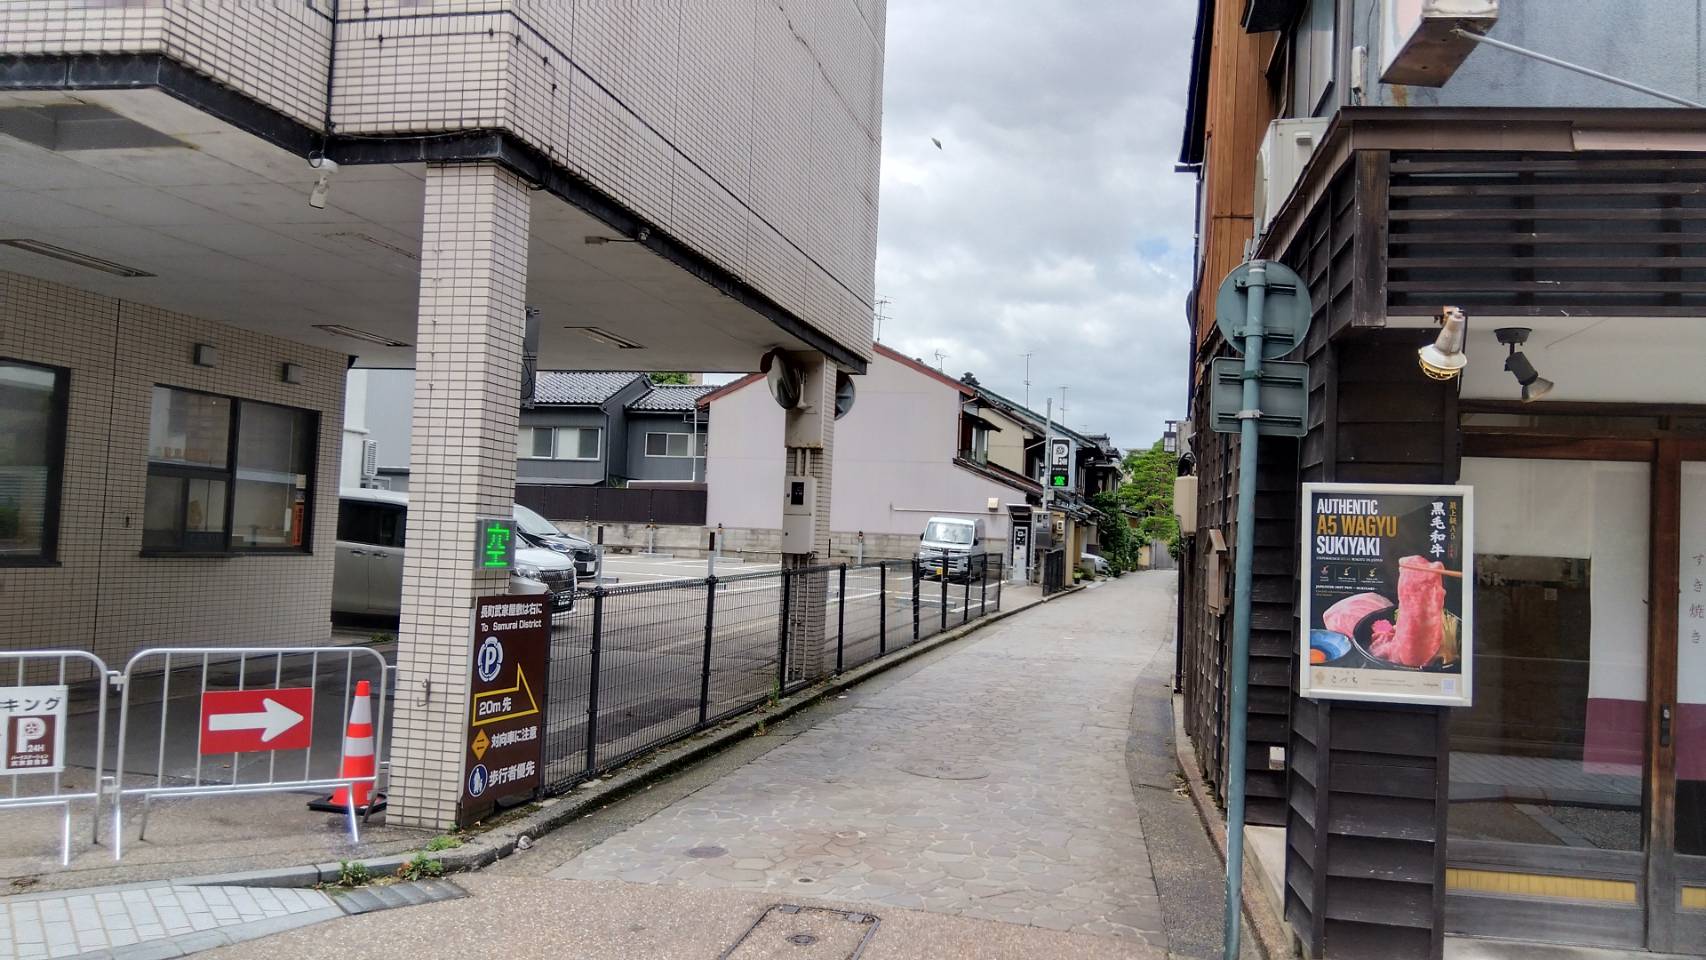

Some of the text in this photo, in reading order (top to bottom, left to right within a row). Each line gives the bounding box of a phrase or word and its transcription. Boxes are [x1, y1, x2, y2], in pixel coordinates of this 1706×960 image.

[1316, 498, 1378, 515] AUTHENTIC
[1316, 514, 1397, 537] A5 WAGYU
[1430, 501, 1446, 558] 黒毛和牛
[486, 522, 510, 567] 空
[1316, 535, 1381, 556] SUKIYAKI
[1688, 552, 1705, 645] すき焼き
[480, 602, 543, 619] 長町武家屋敷は右に
[480, 619, 542, 632] To Samurai District
[490, 725, 538, 748] 対向車に注意
[27, 744, 46, 753] 24H
[488, 760, 536, 788] 歩行者優先
